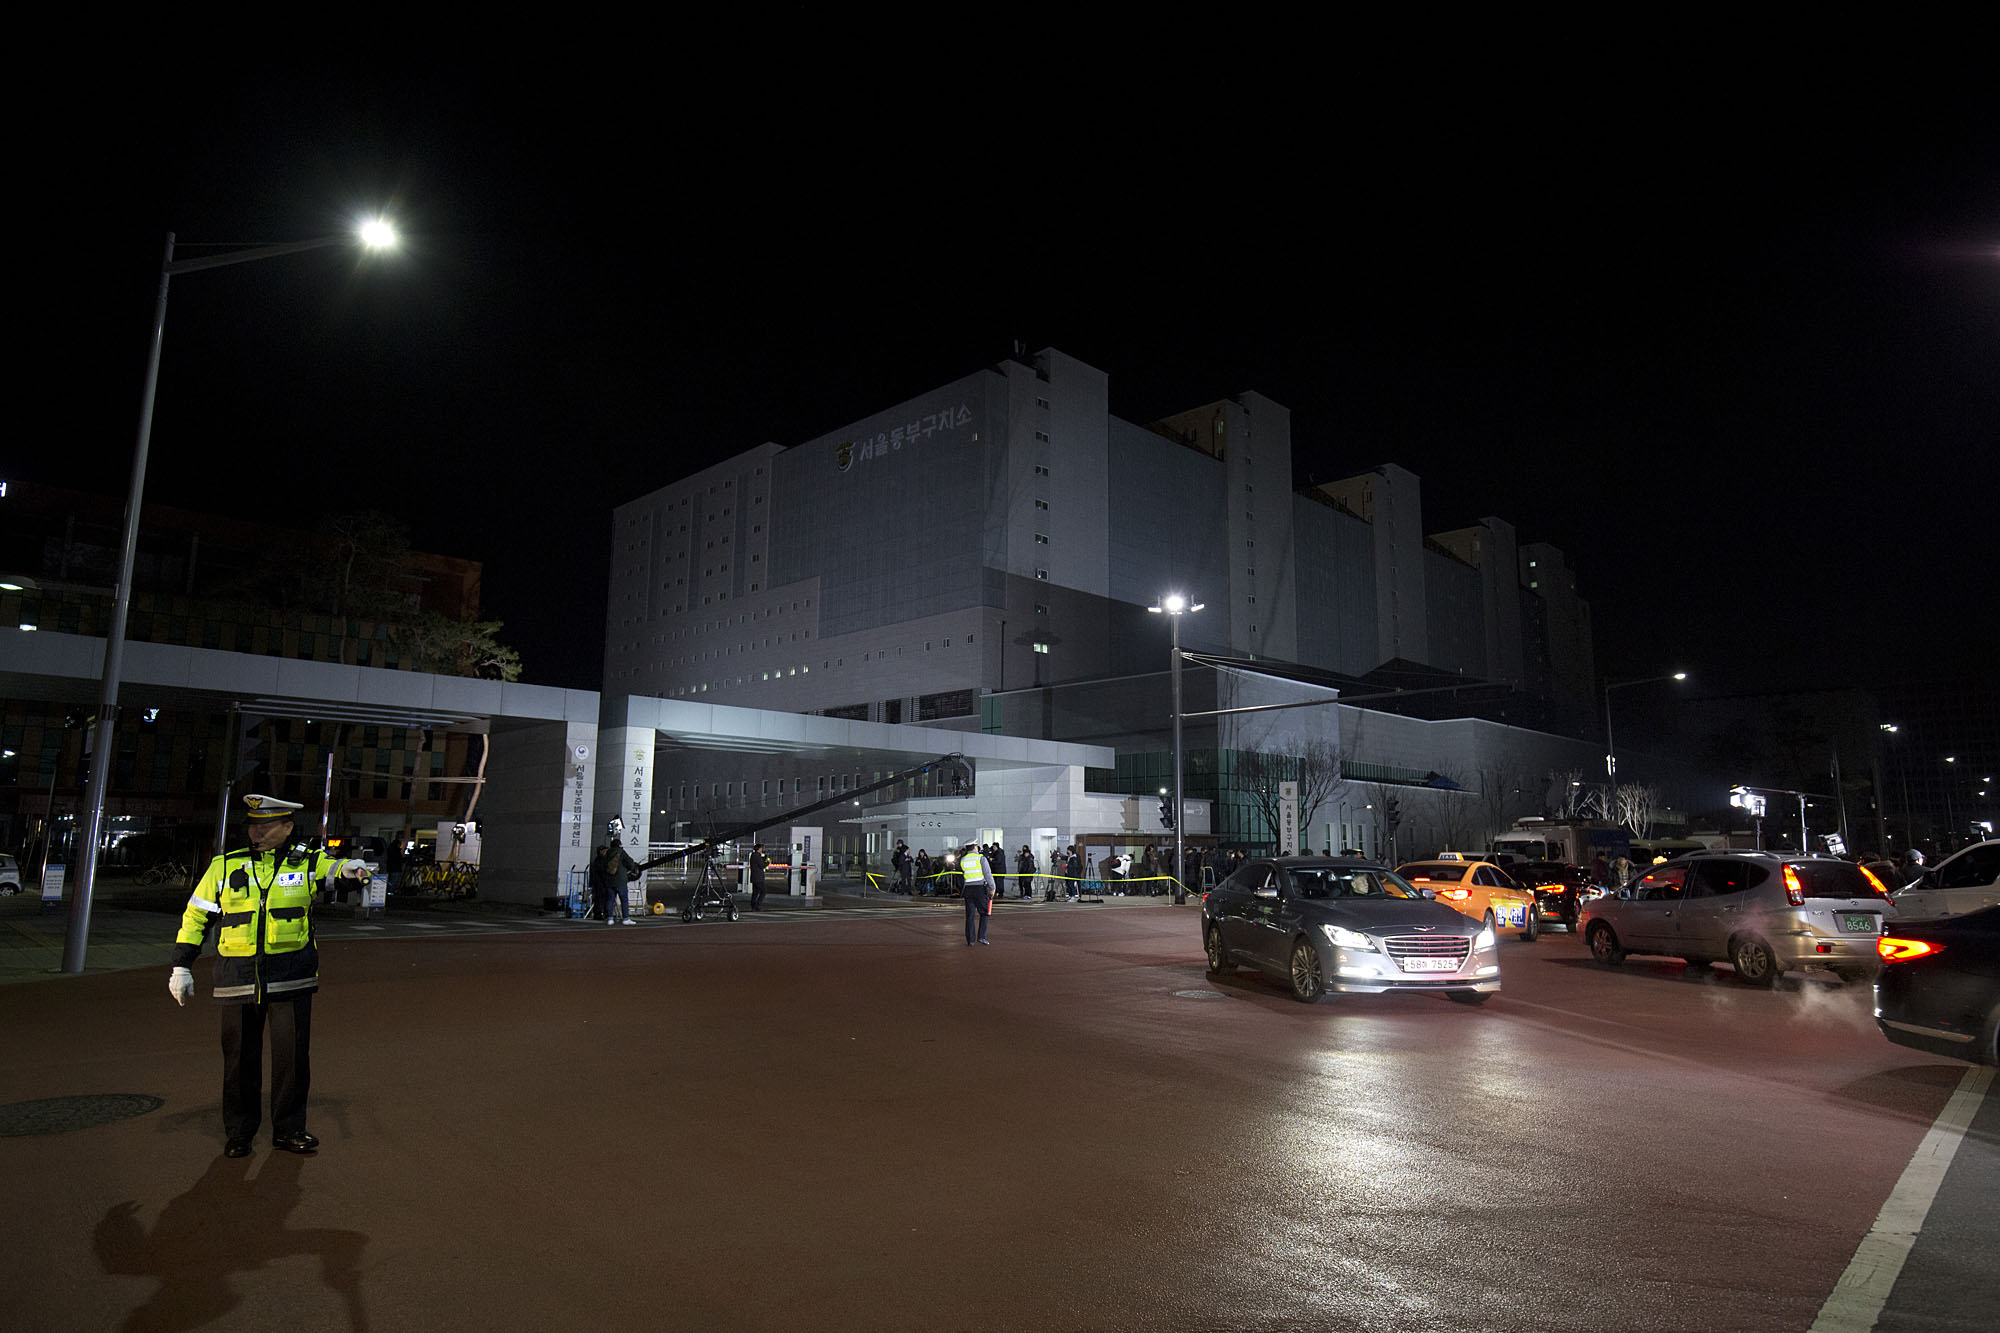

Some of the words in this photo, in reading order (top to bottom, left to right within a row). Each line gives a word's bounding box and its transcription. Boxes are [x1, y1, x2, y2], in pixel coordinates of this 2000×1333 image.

[859, 402, 973, 461] 서울동부구치소
[571, 764, 585, 848] 서울동부준법지원센터
[629, 766, 644, 846] 서울동부구치소
[1846, 921, 1871, 931] 8546
[1431, 959, 1454, 969] 7525
